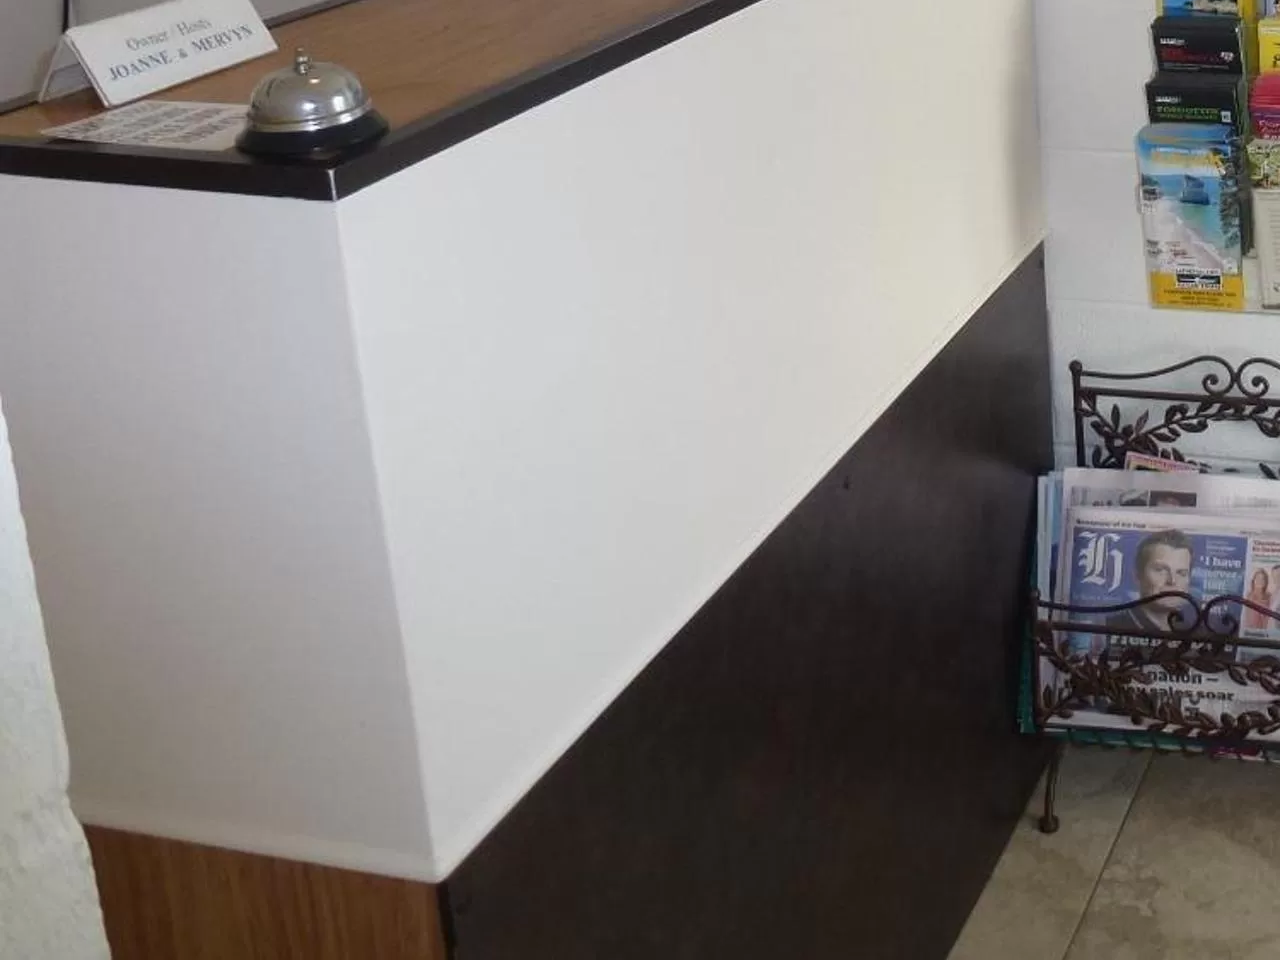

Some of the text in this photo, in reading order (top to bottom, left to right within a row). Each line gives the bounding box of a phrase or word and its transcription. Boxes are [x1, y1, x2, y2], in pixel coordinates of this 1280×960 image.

[109, 24, 253, 80] JOANNE & MERVYN
